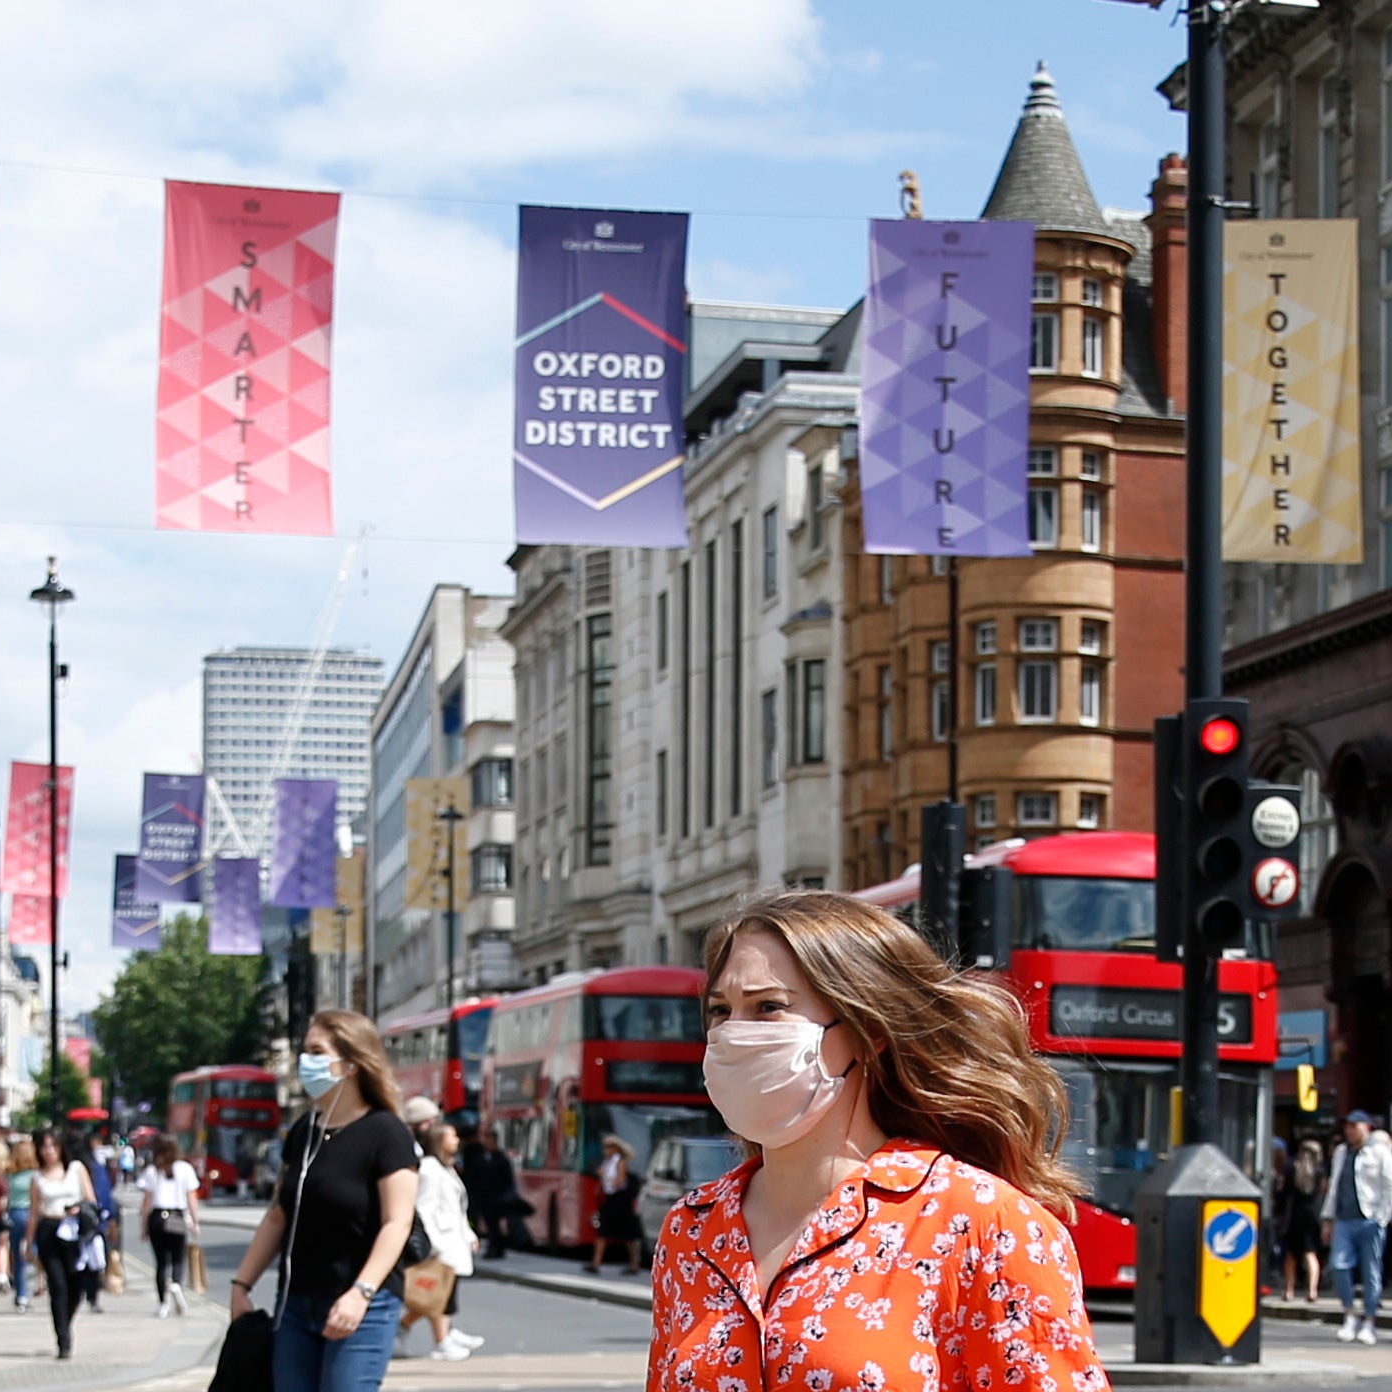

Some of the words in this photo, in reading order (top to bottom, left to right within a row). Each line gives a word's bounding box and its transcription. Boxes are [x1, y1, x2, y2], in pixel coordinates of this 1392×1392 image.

[532, 350, 666, 380] OXFORD
[231, 241, 262, 520] SMARTER
[537, 385, 660, 415] STREET
[933, 272, 959, 548] FUTURE
[1266, 272, 1292, 547] TOGETHER
[524, 419, 673, 449] DISTRICT
[1059, 1000, 1119, 1024] Oxford
[1122, 1002, 1176, 1027] Circus
